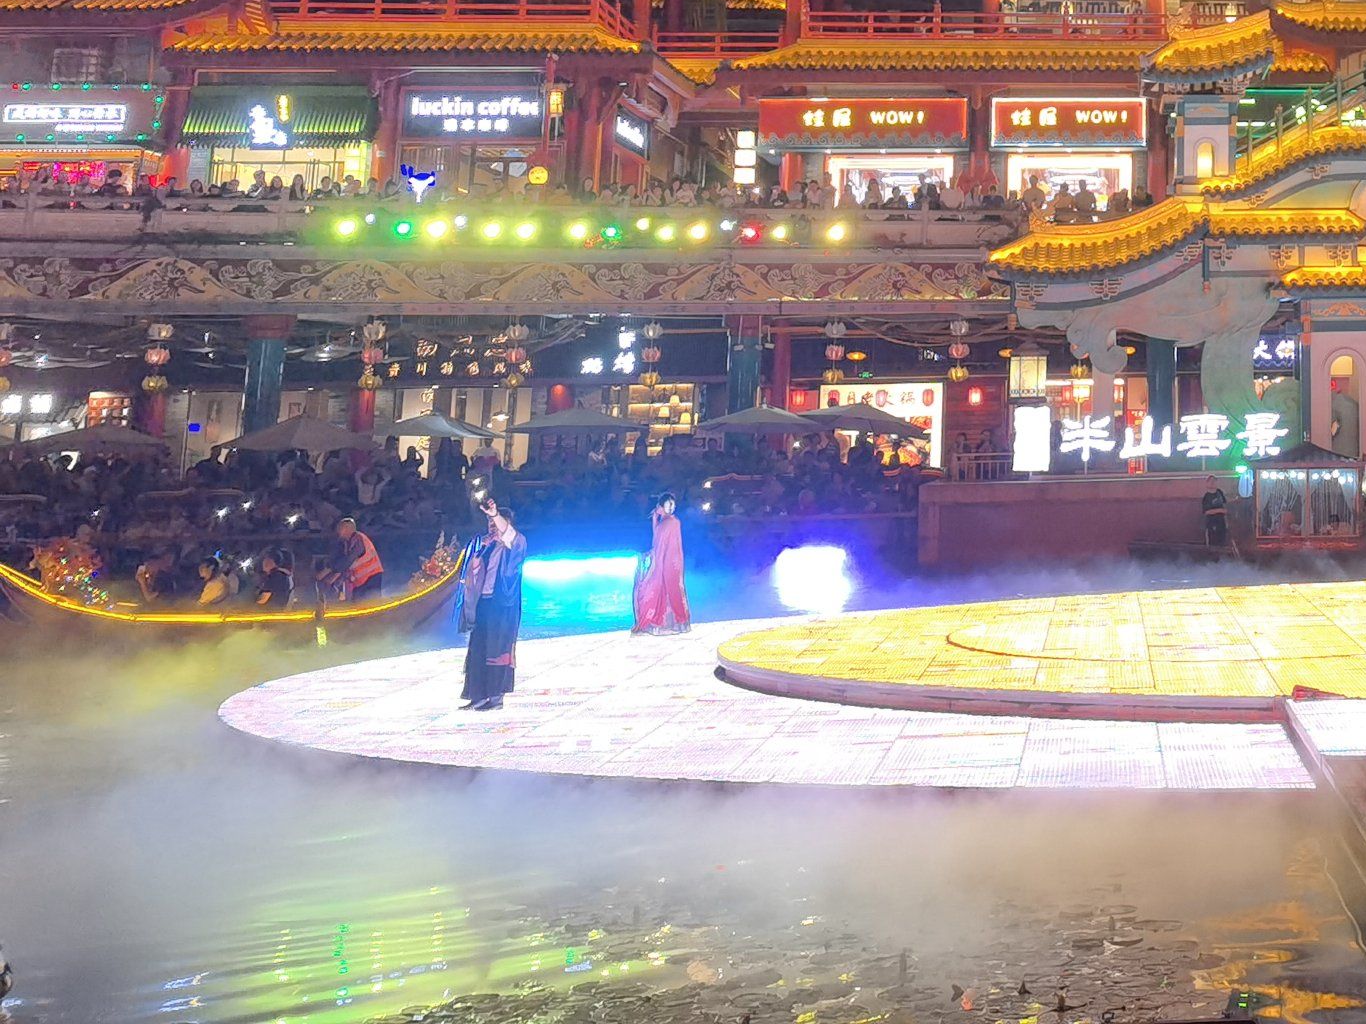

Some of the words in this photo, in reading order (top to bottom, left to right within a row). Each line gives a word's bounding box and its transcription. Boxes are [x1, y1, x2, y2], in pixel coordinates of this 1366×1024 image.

[411, 96, 474, 116] luckin
[477, 96, 539, 116] coffee
[869, 110, 925, 125] WOW!
[1075, 109, 1129, 125] WOW!
[1059, 412, 1289, 462] 半山雲景
